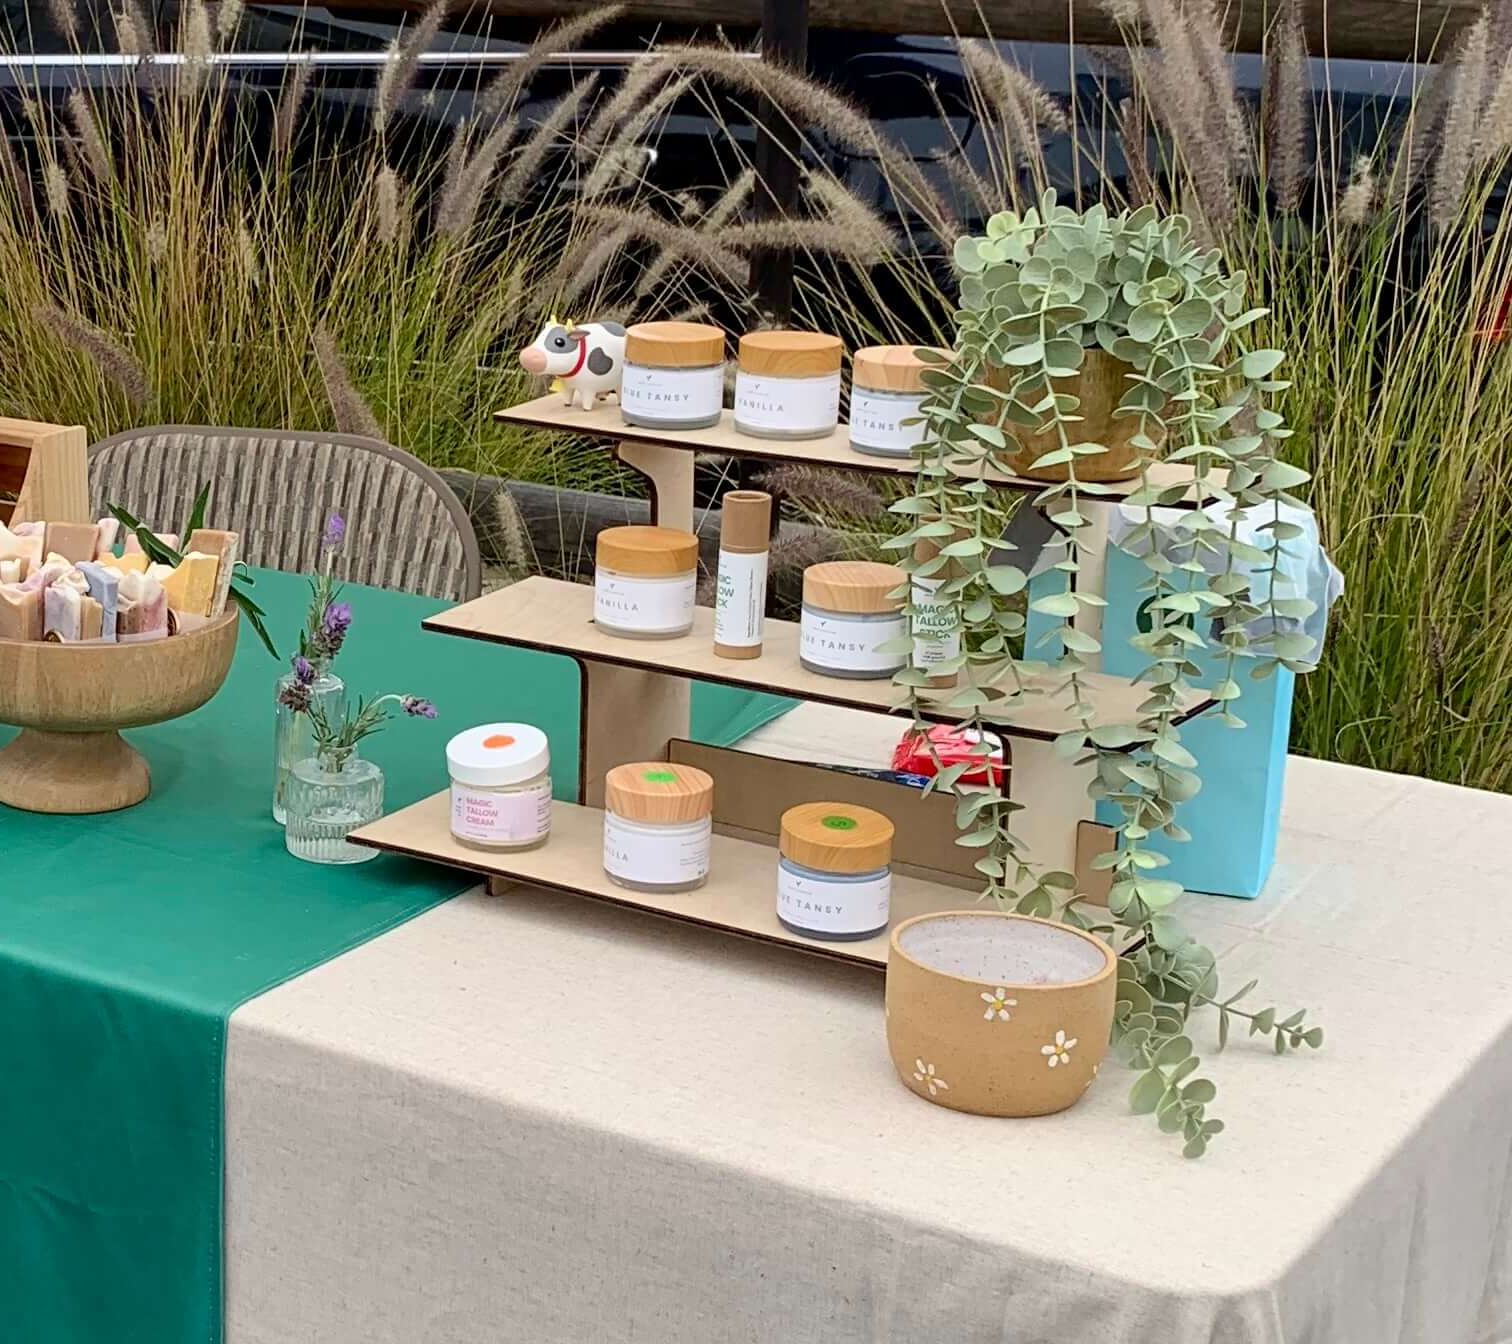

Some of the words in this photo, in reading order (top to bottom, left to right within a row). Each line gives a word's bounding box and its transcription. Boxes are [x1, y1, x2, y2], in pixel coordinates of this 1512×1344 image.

[648, 392, 689, 402] TANSY
[916, 615, 956, 627] TALLOW
[820, 639, 866, 652] TANSY
[466, 797, 494, 808] MAGIC
[466, 806, 498, 817] TALLOW
[465, 816, 495, 826] CREAM
[796, 899, 843, 914] TANSY
